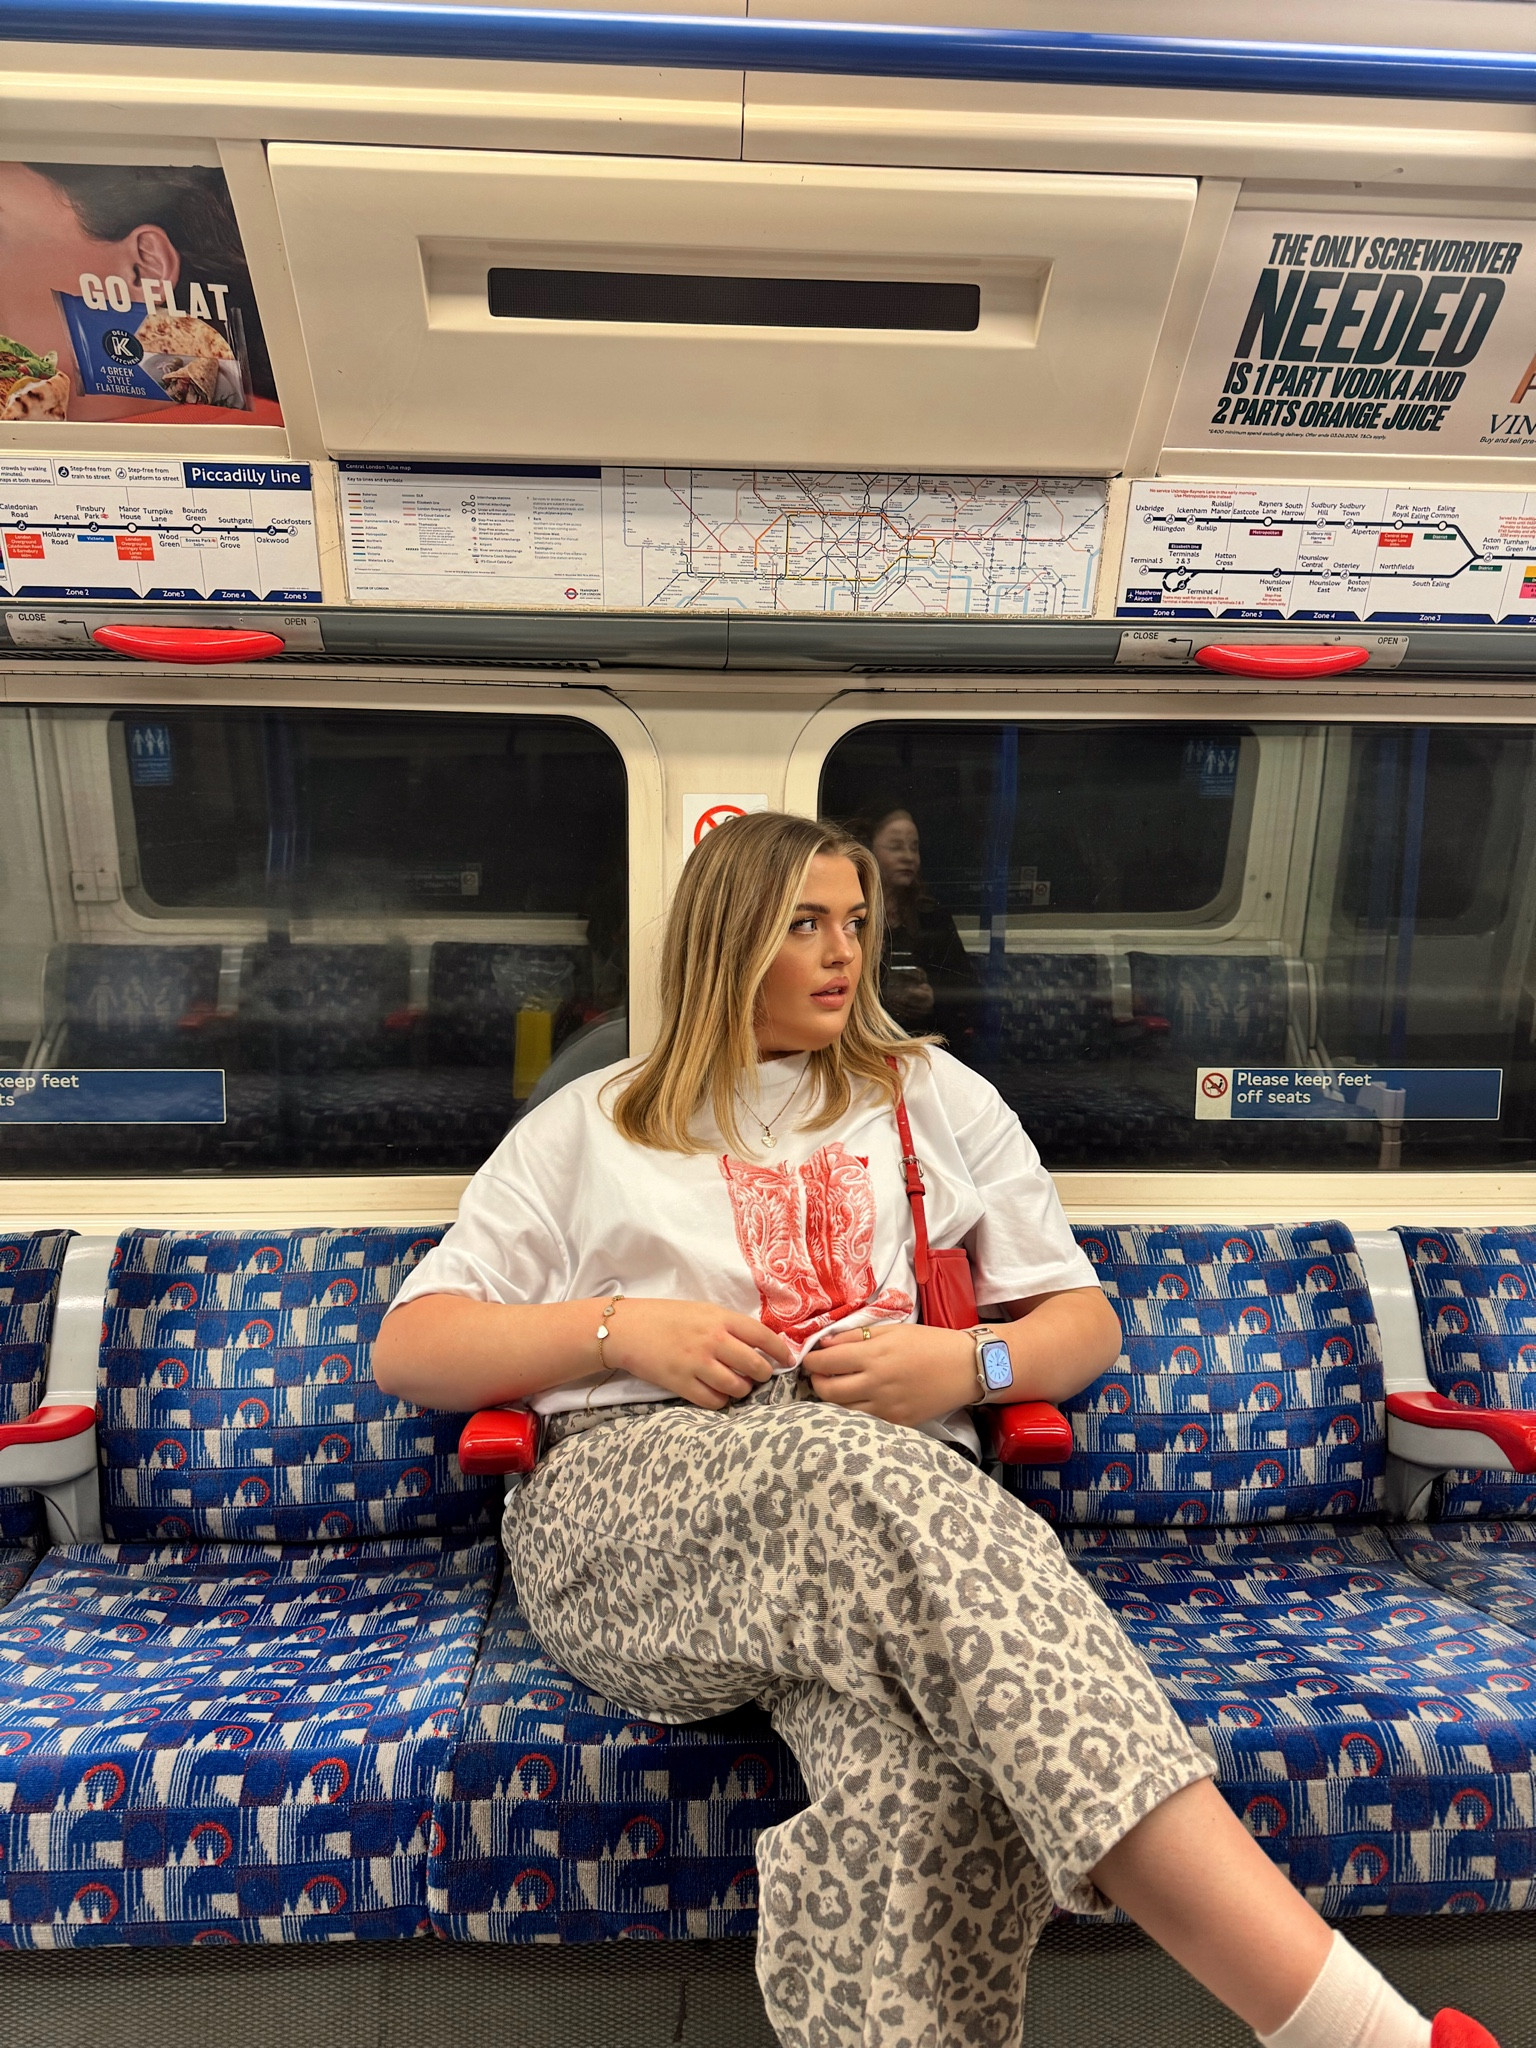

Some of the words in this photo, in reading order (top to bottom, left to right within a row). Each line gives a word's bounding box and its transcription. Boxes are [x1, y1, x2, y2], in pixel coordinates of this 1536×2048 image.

[1268, 233, 1313, 266] THE
[1310, 234, 1370, 270] ONLY
[1364, 237, 1522, 275] SCREWDRIVER
[79, 273, 131, 313] GO
[141, 277, 229, 322] FLAT
[1233, 268, 1506, 368] NEEDED
[112, 336, 131, 357] K
[110, 354, 140, 365] KITCHEN
[100, 366, 106, 375] 4
[108, 367, 135, 377] GREEK
[107, 375, 131, 386] STYLE
[1222, 362, 1253, 395] IS
[1253, 364, 1269, 396] 1
[1266, 364, 1334, 398] PART
[1329, 367, 1414, 401] VODKA
[1410, 370, 1467, 402] AND
[96, 383, 146, 396] FLATBREADS
[1211, 397, 1231, 424] 2
[1229, 398, 1302, 427] PARTS
[1298, 401, 1386, 430] ORANGE
[1382, 403, 1451, 432] JUICE
[191, 468, 266, 485] Piccadilly
[271, 470, 300, 483] line
[143, 508, 173, 516] Turnpike
[218, 517, 252, 525] Southgate
[42, 531, 75, 539] Holloway
[1333, 562, 1360, 570] Osterley
[18, 613, 46, 622] CLOSE
[284, 618, 307, 626] OPEN
[1133, 632, 1159, 640] CLOSE
[1377, 637, 1399, 645] OPEN
[42, 1074, 79, 1088] feet
[1237, 1073, 1288, 1086] Please
[1294, 1073, 1332, 1089] keep
[1337, 1073, 1372, 1086] feet
[1237, 1090, 1263, 1103] off
[1268, 1092, 1311, 1104] seats
